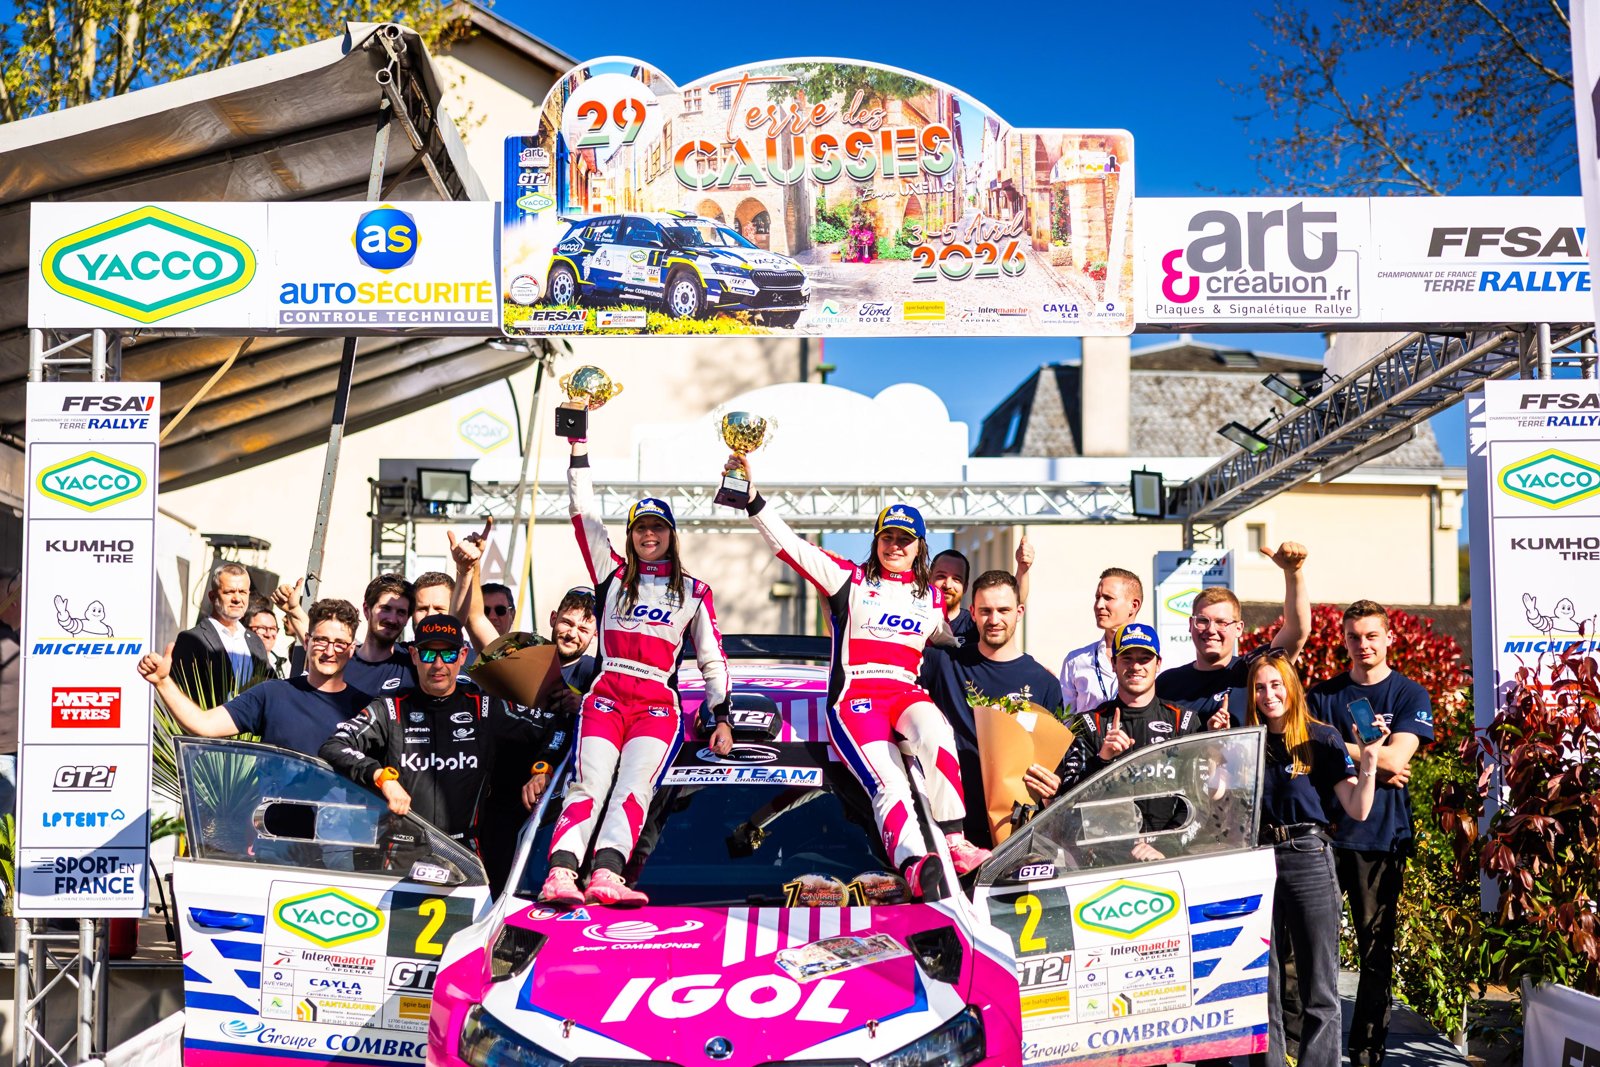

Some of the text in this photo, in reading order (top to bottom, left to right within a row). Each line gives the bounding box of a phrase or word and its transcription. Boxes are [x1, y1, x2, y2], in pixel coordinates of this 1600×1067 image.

[709, 72, 886, 142] Terre des
[577, 98, 647, 147] 29
[674, 124, 954, 190] CAUSSES
[519, 172, 550, 184] GT2i
[964, 211, 1025, 244] Avril
[360, 223, 412, 253] as
[1187, 201, 1338, 274] art
[1427, 226, 1583, 258] FFSA
[560, 244, 579, 252] YACCO
[76, 250, 223, 281] YACCO
[912, 241, 1027, 283] 2026
[1423, 271, 1592, 292] TERRE RALLYE
[859, 302, 893, 316] Ford
[1043, 304, 1078, 312] CAYLA
[1155, 303, 1353, 317] Plaques & Signalétique Rallye
[282, 310, 491, 323] CONTROLE TECHNIQUE
[533, 311, 581, 321] FFSA
[62, 396, 142, 411] FFSA
[1519, 393, 1600, 409] FFSA
[87, 418, 149, 429] RALLYE
[1546, 415, 1600, 427] RALLY
[54, 474, 130, 490] YACCO
[1516, 472, 1592, 488] YACCO
[46, 540, 134, 552] KUMHO
[1511, 537, 1600, 550] KUMHO
[93, 554, 134, 563] TIRE
[1176, 557, 1220, 566] FFSA
[1559, 552, 1600, 561] TIRE
[422, 624, 457, 635] Kubota
[879, 613, 922, 634] IGOL
[32, 643, 142, 655] MICHELIN
[52, 692, 120, 707] MRF
[60, 709, 111, 720] TYRES
[401, 752, 478, 771] Kubota
[54, 766, 117, 789] GT2i
[734, 768, 817, 780] TEAM
[54, 856, 135, 874] SPORT EN
[1020, 865, 1054, 878] GT2i
[54, 876, 134, 894] FRANCE
[783, 881, 803, 908] 1
[848, 881, 867, 908] 1
[1091, 898, 1164, 921] YACCO
[292, 908, 368, 929] YACCO
[1014, 894, 1047, 952] 2
[414, 898, 447, 956] 2
[611, 942, 701, 950] COMBRONDE
[1134, 952, 1178, 961] CAPDENAC
[325, 967, 373, 975] CAPDENAC
[1125, 966, 1174, 979] CAYLA
[309, 978, 362, 989] CAYLA
[1079, 981, 1106, 989] AVEYRON
[403, 1001, 416, 1009] spie
[600, 974, 848, 1024] IGOL
[1022, 1009, 1235, 1061] Groupe COMBRONDE
[257, 1028, 428, 1058] Groupe COMBRO
